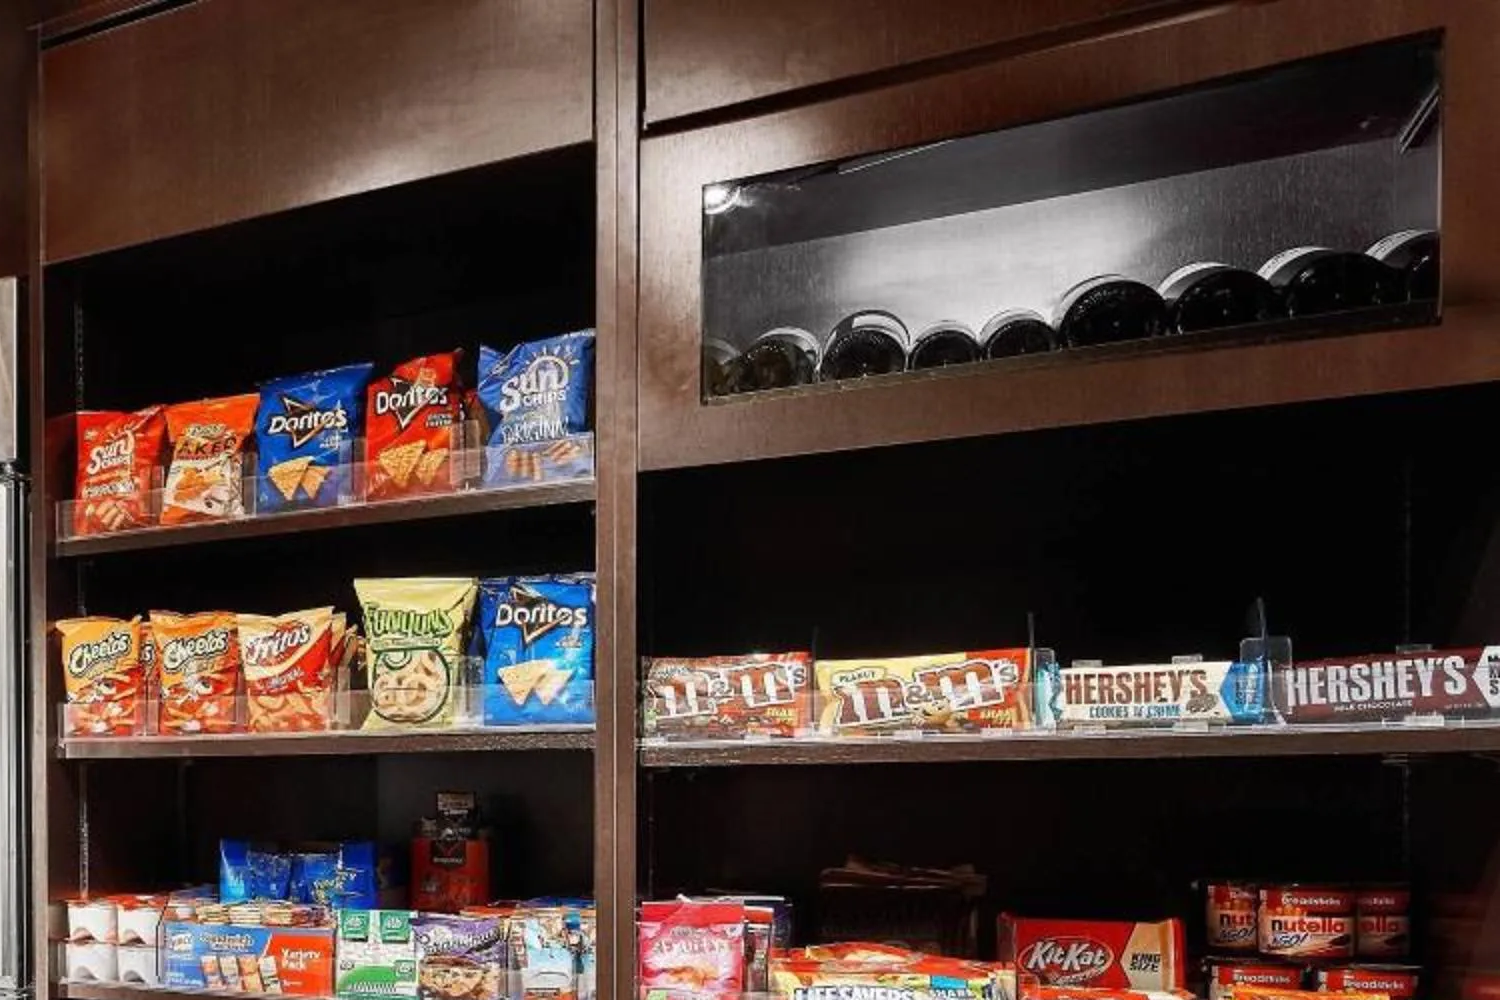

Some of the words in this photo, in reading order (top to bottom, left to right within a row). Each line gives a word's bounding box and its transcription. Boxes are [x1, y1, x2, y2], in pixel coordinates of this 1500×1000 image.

[376, 386, 448, 414] Doritos
[268, 408, 348, 434] Doritos
[496, 602, 587, 627] Doritos
[68, 632, 131, 676] Cheetos
[162, 630, 230, 672] Cheetos
[245, 623, 309, 665] Fritos
[839, 671, 877, 683] PEANUT
[1065, 669, 1207, 705] HERSHEY'S
[1284, 655, 1468, 708] HERSHEY'S
[1089, 707, 1129, 718] COOKIES
[1271, 917, 1345, 934] nutella
[281, 948, 321, 960] Variety
[282, 960, 307, 971] Pack
[1132, 953, 1161, 963] KING
[1130, 962, 1159, 972] SIZE
